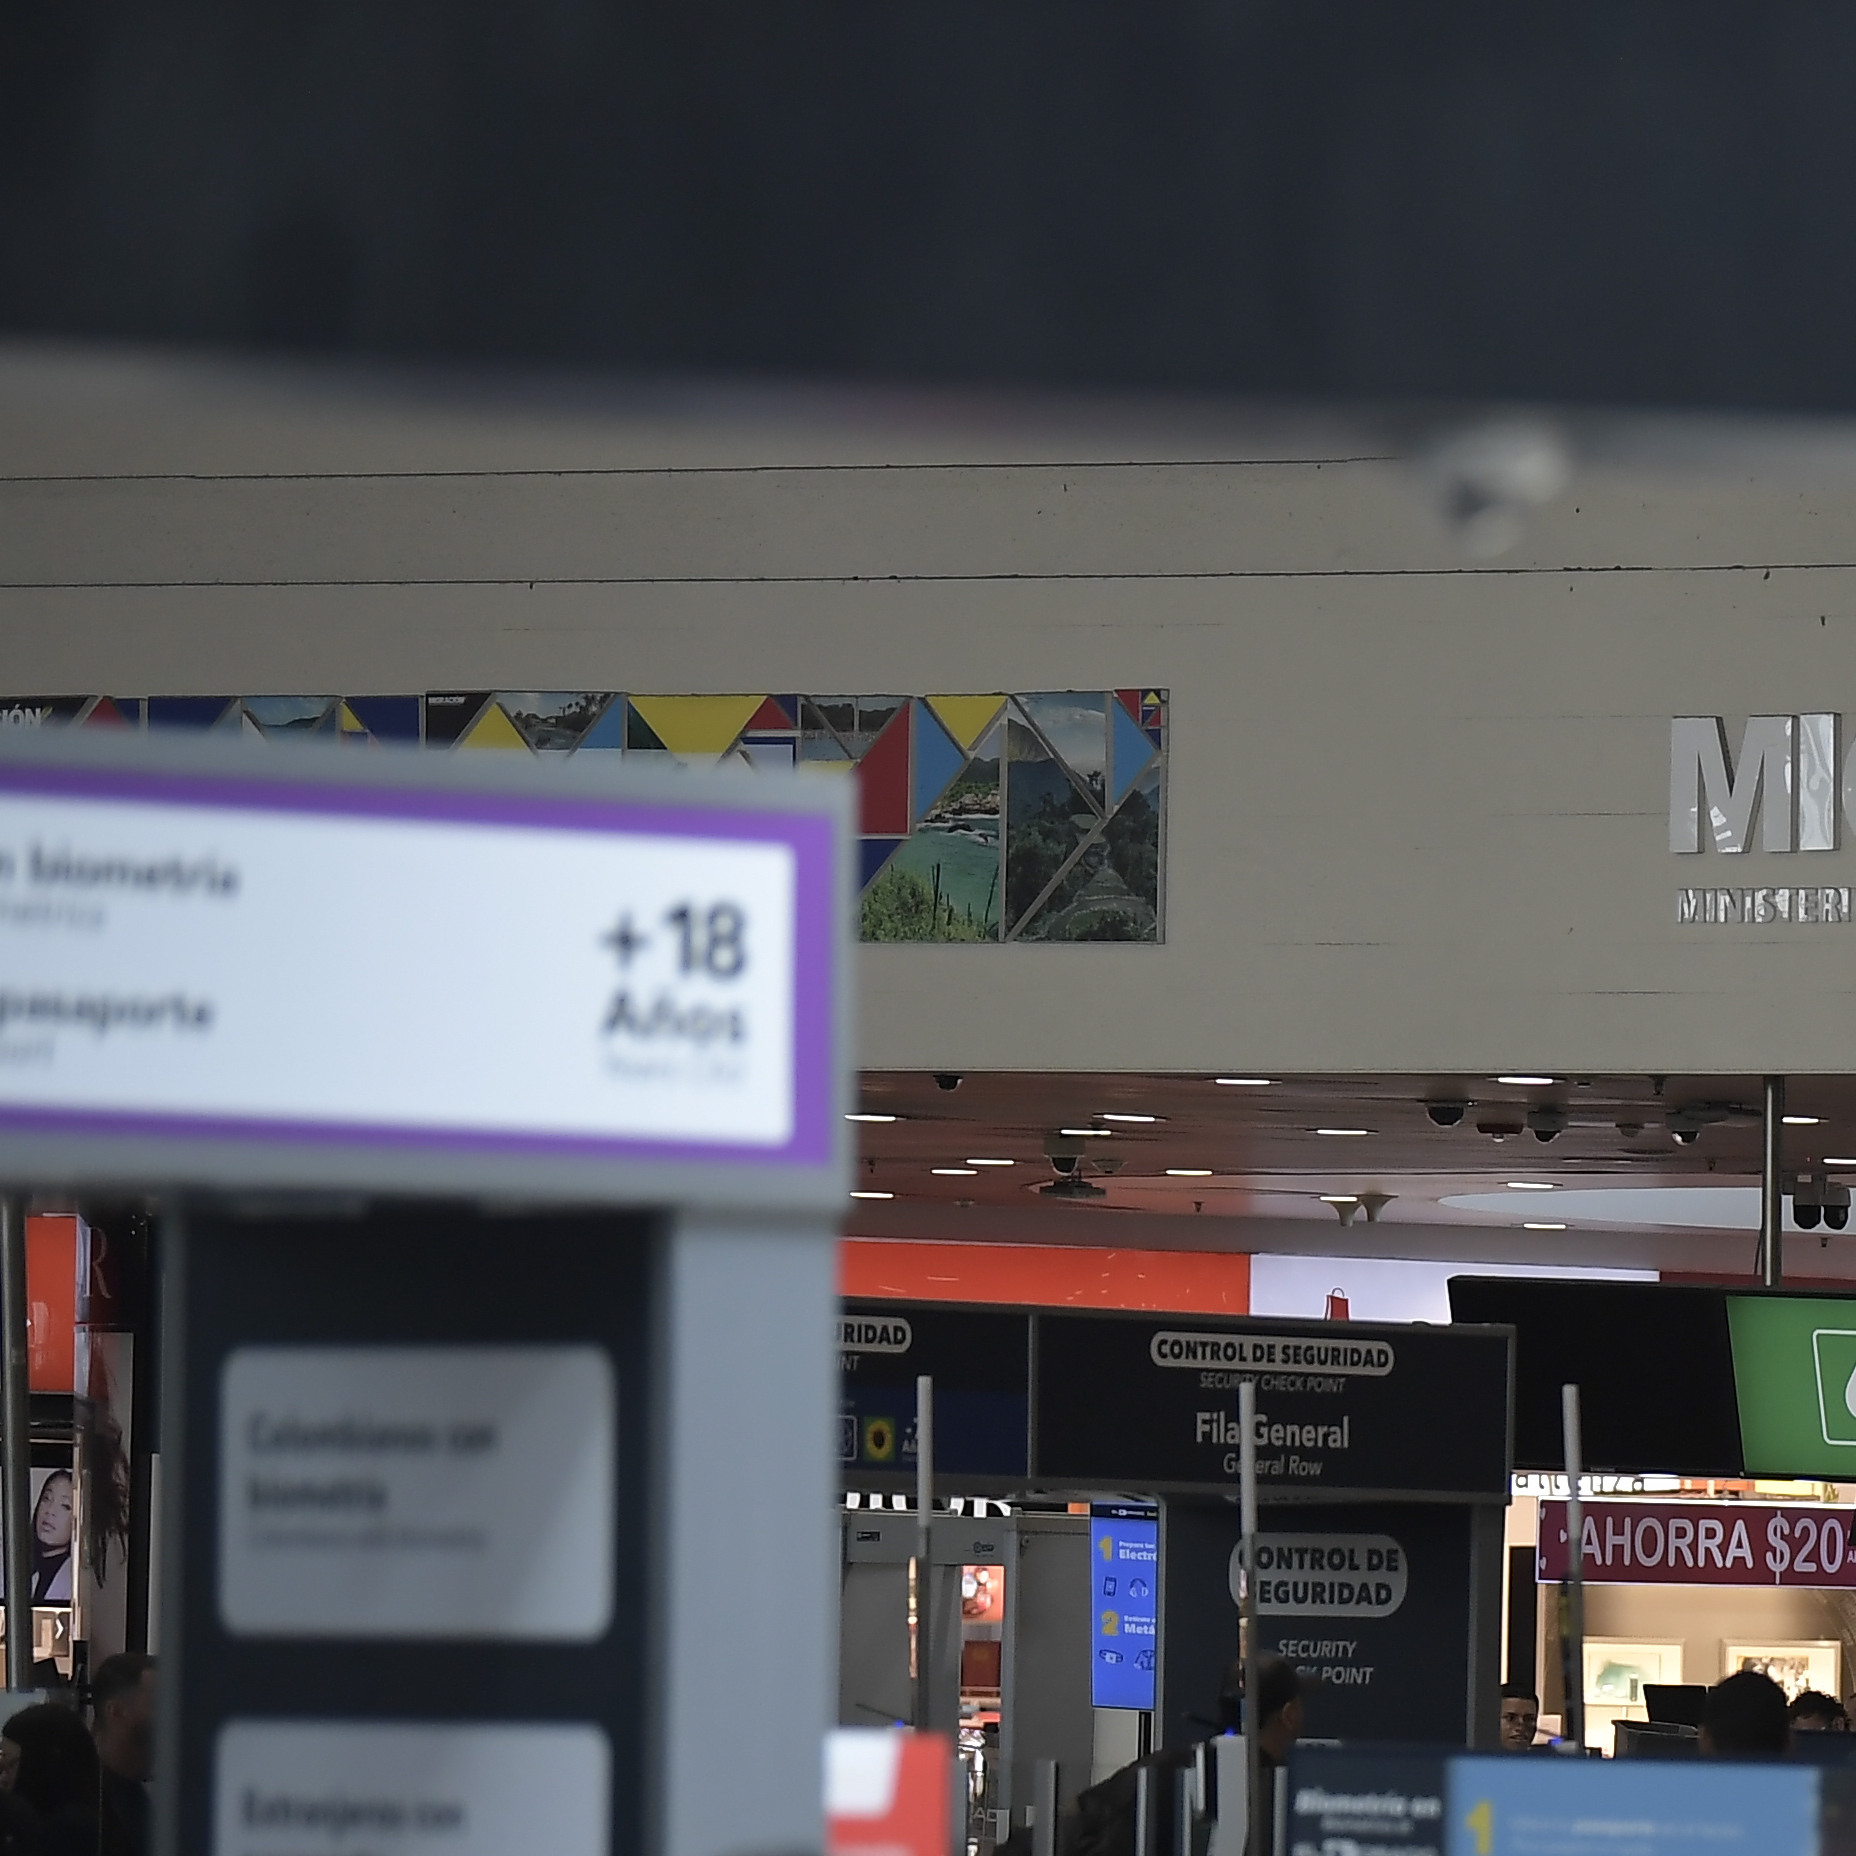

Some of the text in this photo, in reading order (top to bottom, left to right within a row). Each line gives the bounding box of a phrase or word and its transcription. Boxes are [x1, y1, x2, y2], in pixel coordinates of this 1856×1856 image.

[602, 898, 747, 980] +18
[602, 990, 745, 1046] Años
[838, 1321, 907, 1346] RIDAD
[1156, 1338, 1390, 1369] CONTROL DE SEGURIDAD
[1260, 1374, 1302, 1392] CHECK
[1306, 1376, 1347, 1393] POINT
[1195, 1410, 1351, 1449] Fila General
[1223, 1452, 1324, 1477] Geral Row
[1579, 1515, 1754, 1569] AHORRA
[1367, 1549, 1400, 1572] DE
[1256, 1579, 1393, 1606] EGURIDAD
[1102, 1609, 1120, 1637] 2
[1277, 1638, 1357, 1658] SECURITY
[1321, 1665, 1375, 1685] POINT
